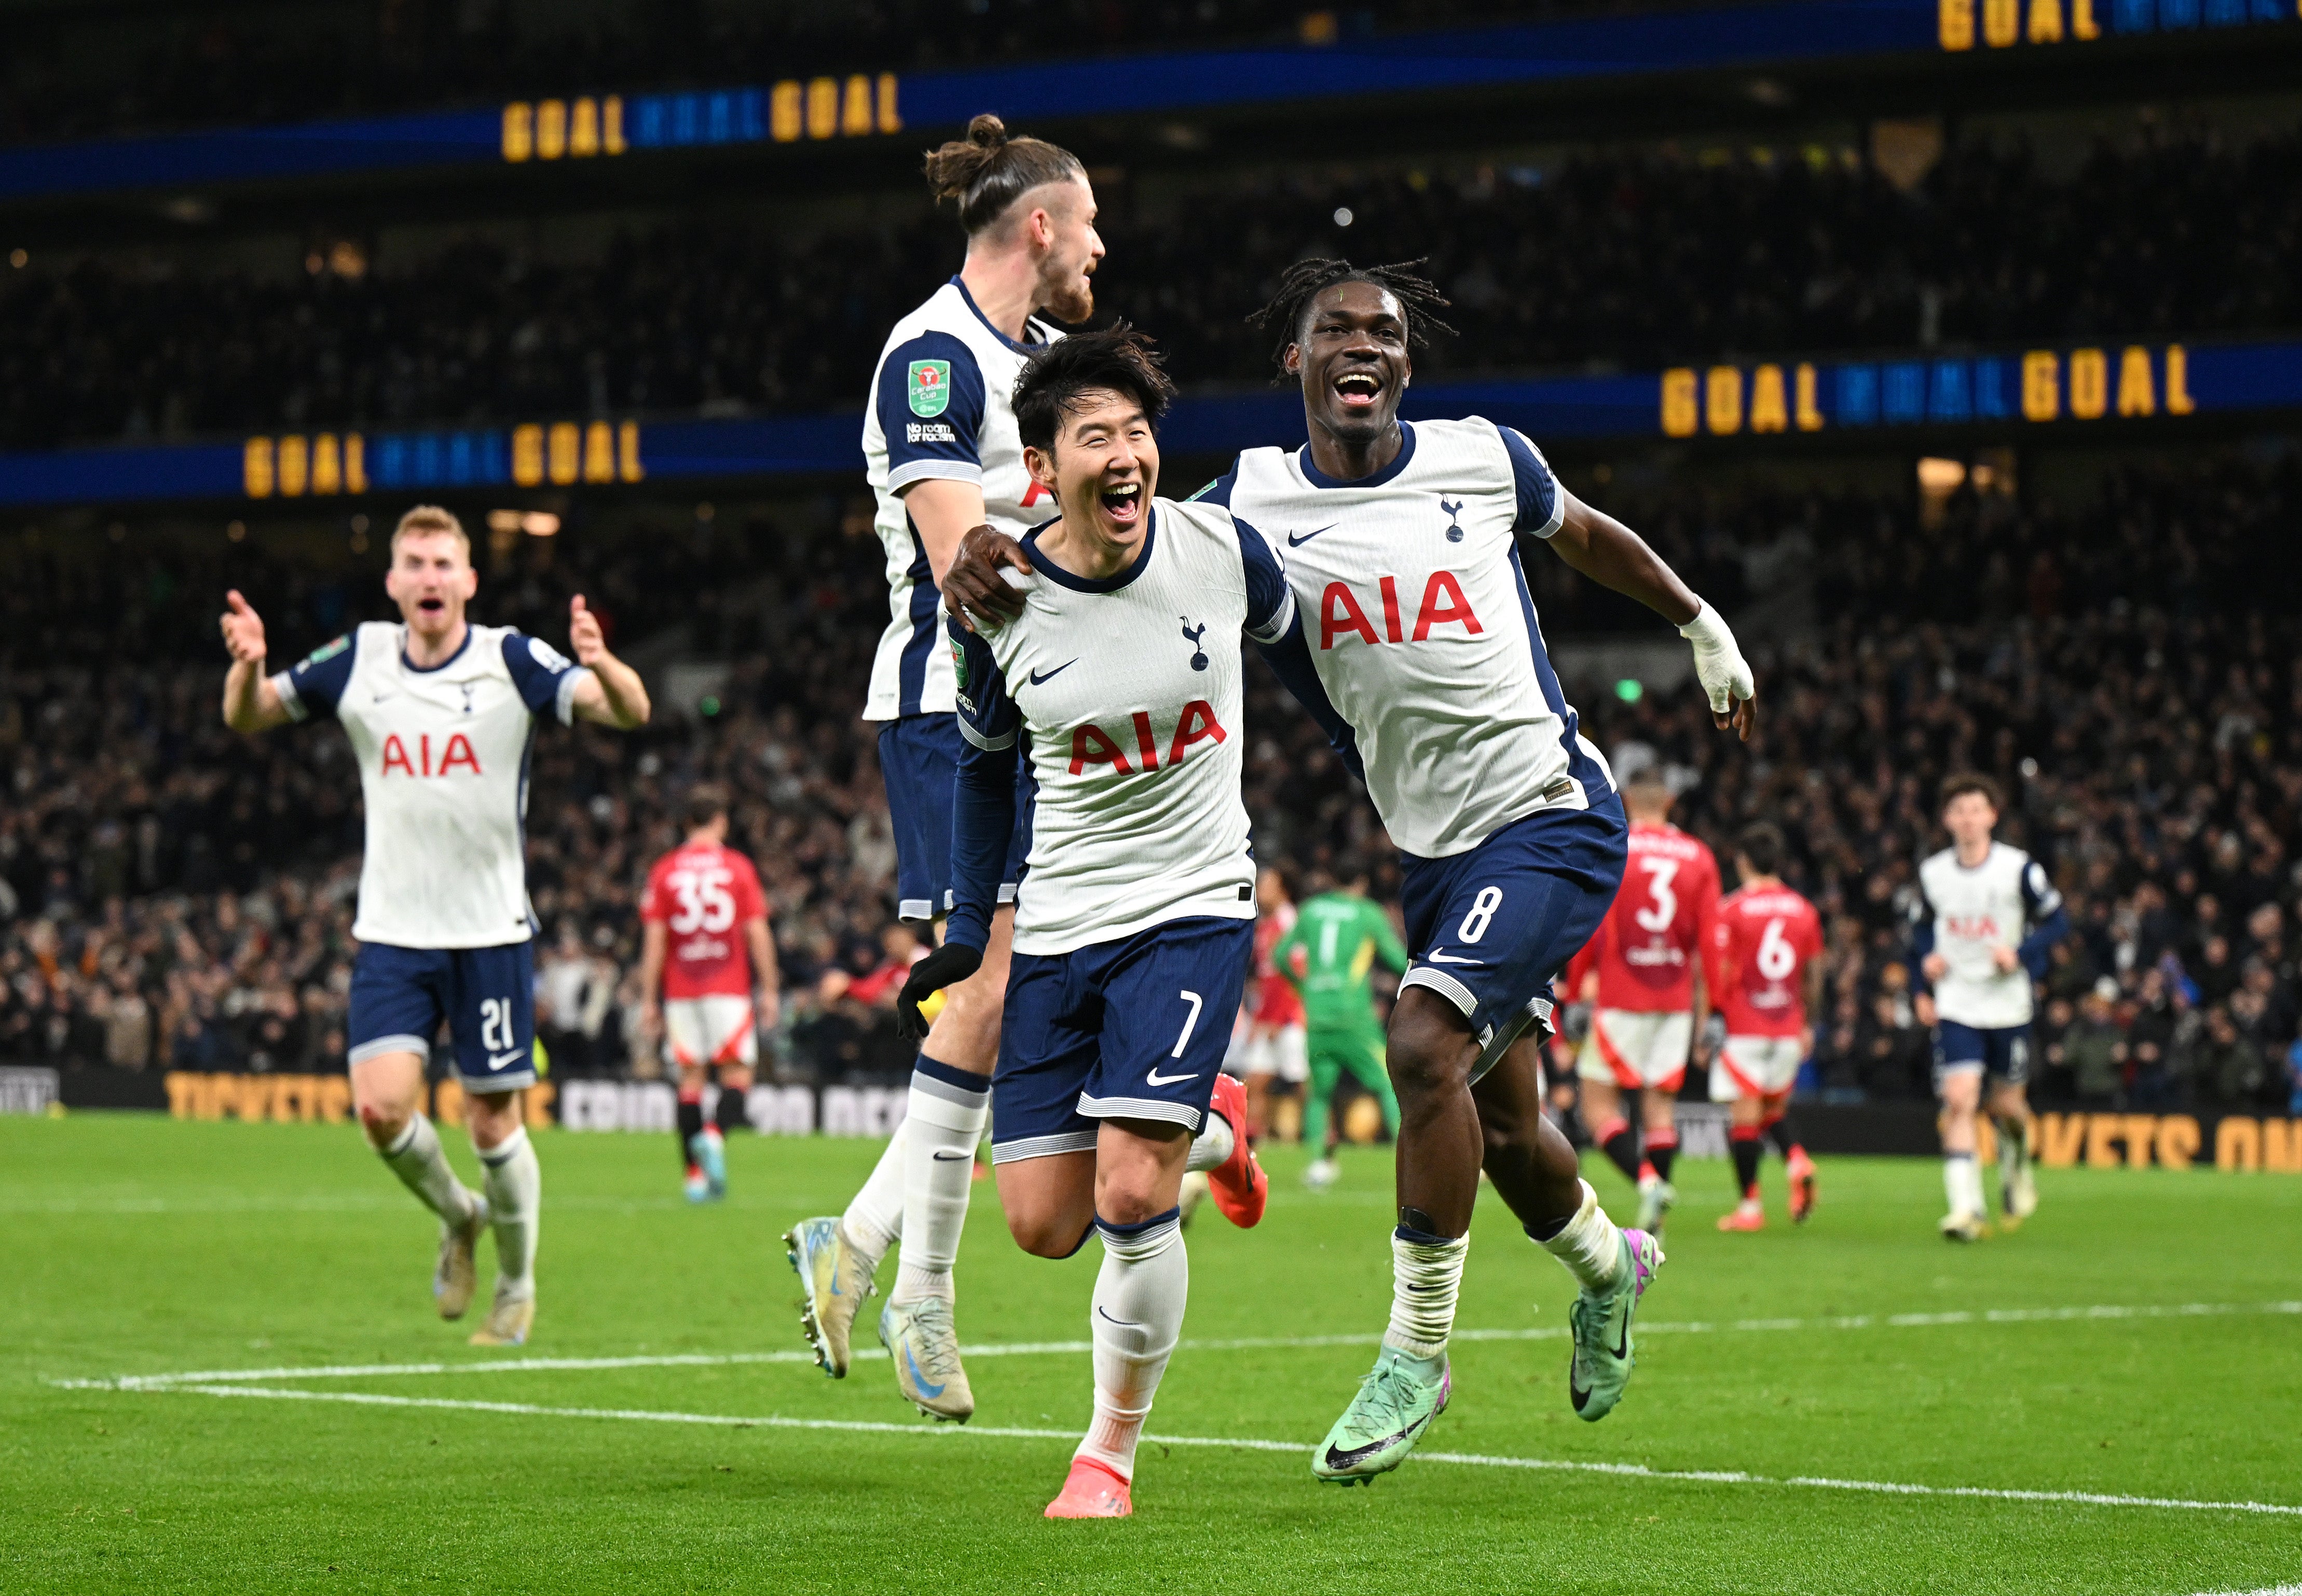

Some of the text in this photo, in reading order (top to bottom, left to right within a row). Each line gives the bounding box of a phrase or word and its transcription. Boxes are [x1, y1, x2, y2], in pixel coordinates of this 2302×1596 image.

[1662, 362, 1825, 438] GOAL
[2021, 345, 2195, 422] GOAL
[906, 422, 951, 434] No room
[907, 433, 956, 443] for racism
[1321, 570, 1484, 650] AIA
[381, 733, 482, 777] AIA
[1068, 700, 1227, 776] AIA
[666, 869, 736, 934] 35
[1458, 886, 1503, 944] 8
[1636, 855, 1679, 933] 3
[1319, 920, 1339, 967] 1
[1757, 917, 1797, 981] 6
[480, 997, 515, 1052] 21
[1171, 989, 1203, 1058] 7
